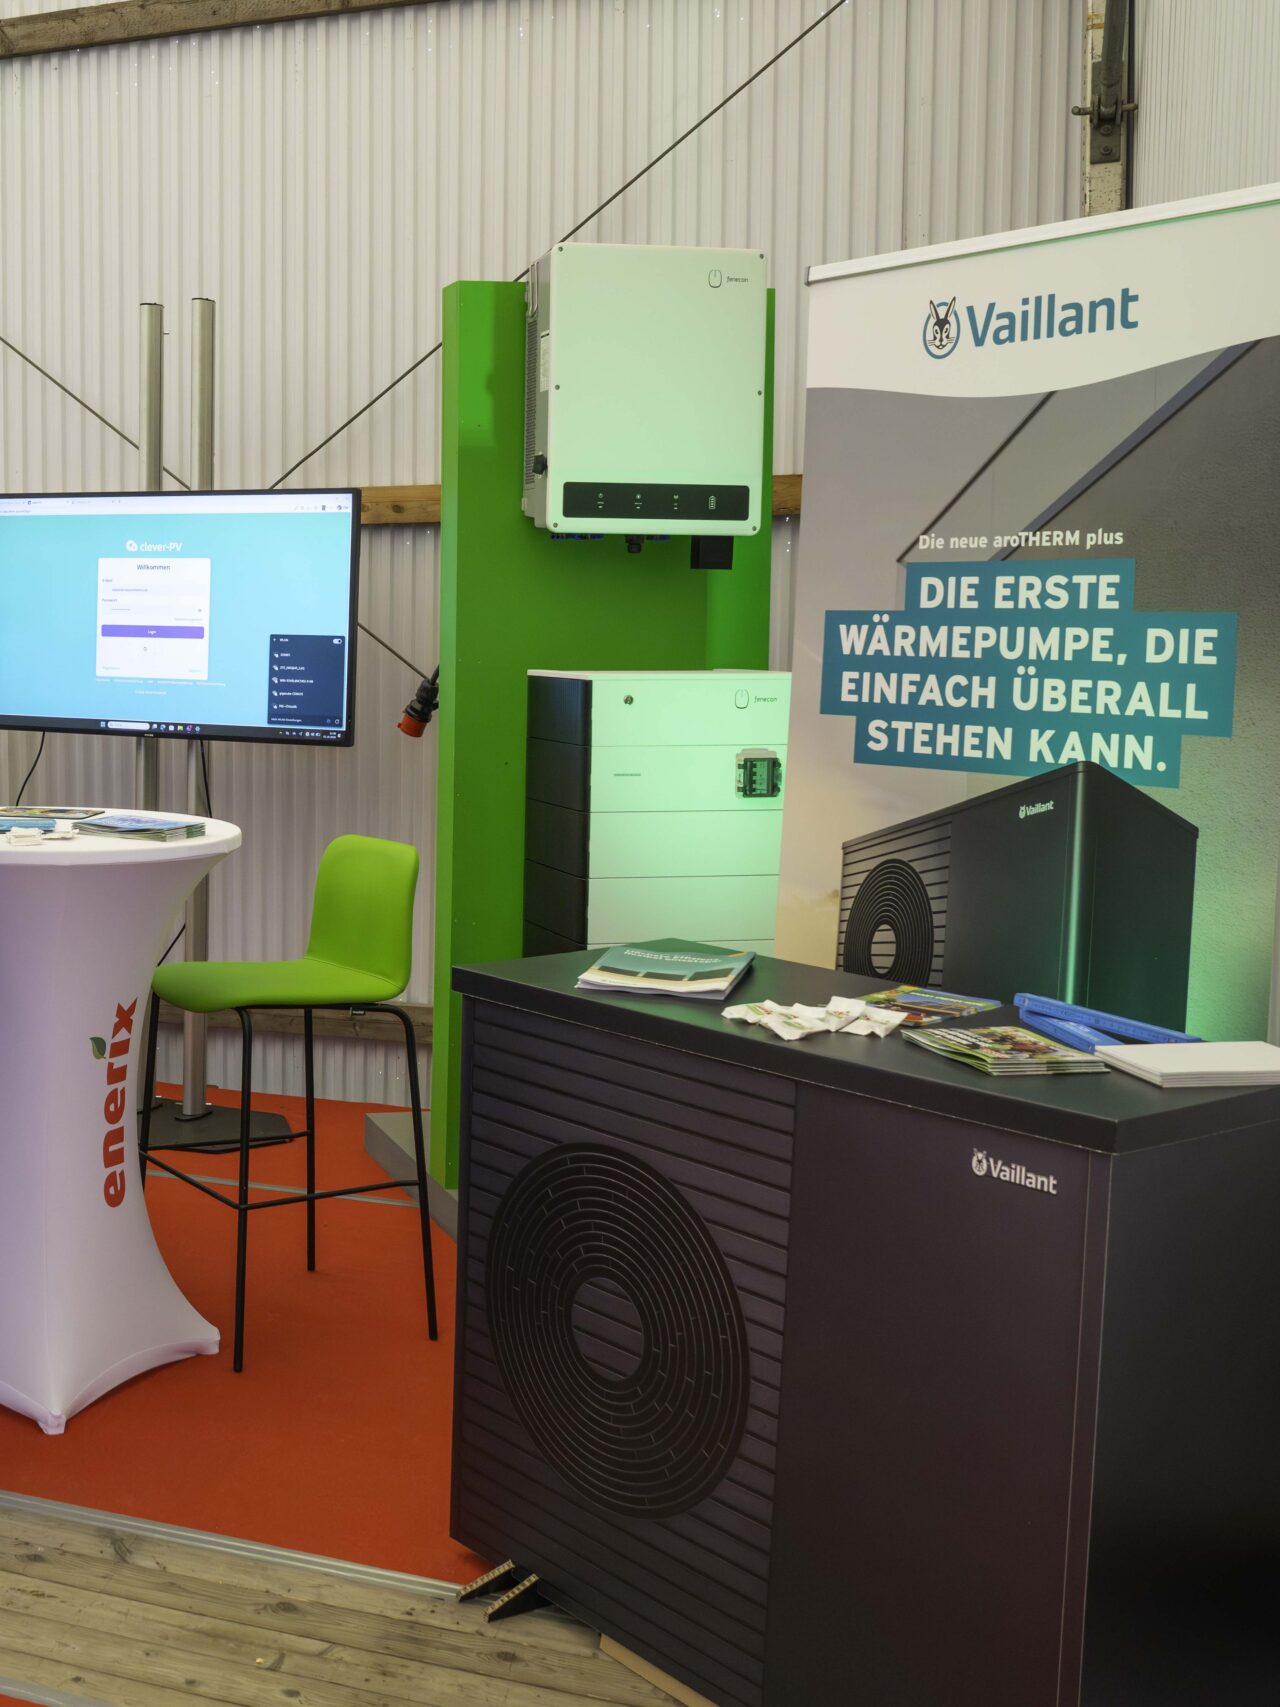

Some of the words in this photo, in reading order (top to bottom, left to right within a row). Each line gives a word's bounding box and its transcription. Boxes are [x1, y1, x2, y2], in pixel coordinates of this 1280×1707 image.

[966, 287, 1140, 348] Vaillant
[139, 542, 183, 552] clever-PV
[919, 534, 945, 550] Die
[950, 535, 988, 549] neue
[993, 530, 1080, 548] aroTHERM
[1086, 528, 1124, 550] plus
[920, 575, 980, 609] DIE
[994, 574, 1120, 610] ERSTE
[839, 613, 1128, 666] WÄRMEPUMPE,
[1145, 627, 1219, 665] DIE
[840, 670, 997, 710] EINFACH
[1012, 665, 1209, 720] ÜBERALL
[866, 719, 1013, 761] STEHEN
[1028, 728, 1167, 773] KANN.
[1026, 800, 1054, 816] Vaillant
[102, 996, 138, 1208] enerix
[987, 1156, 1058, 1195] Vaillant
